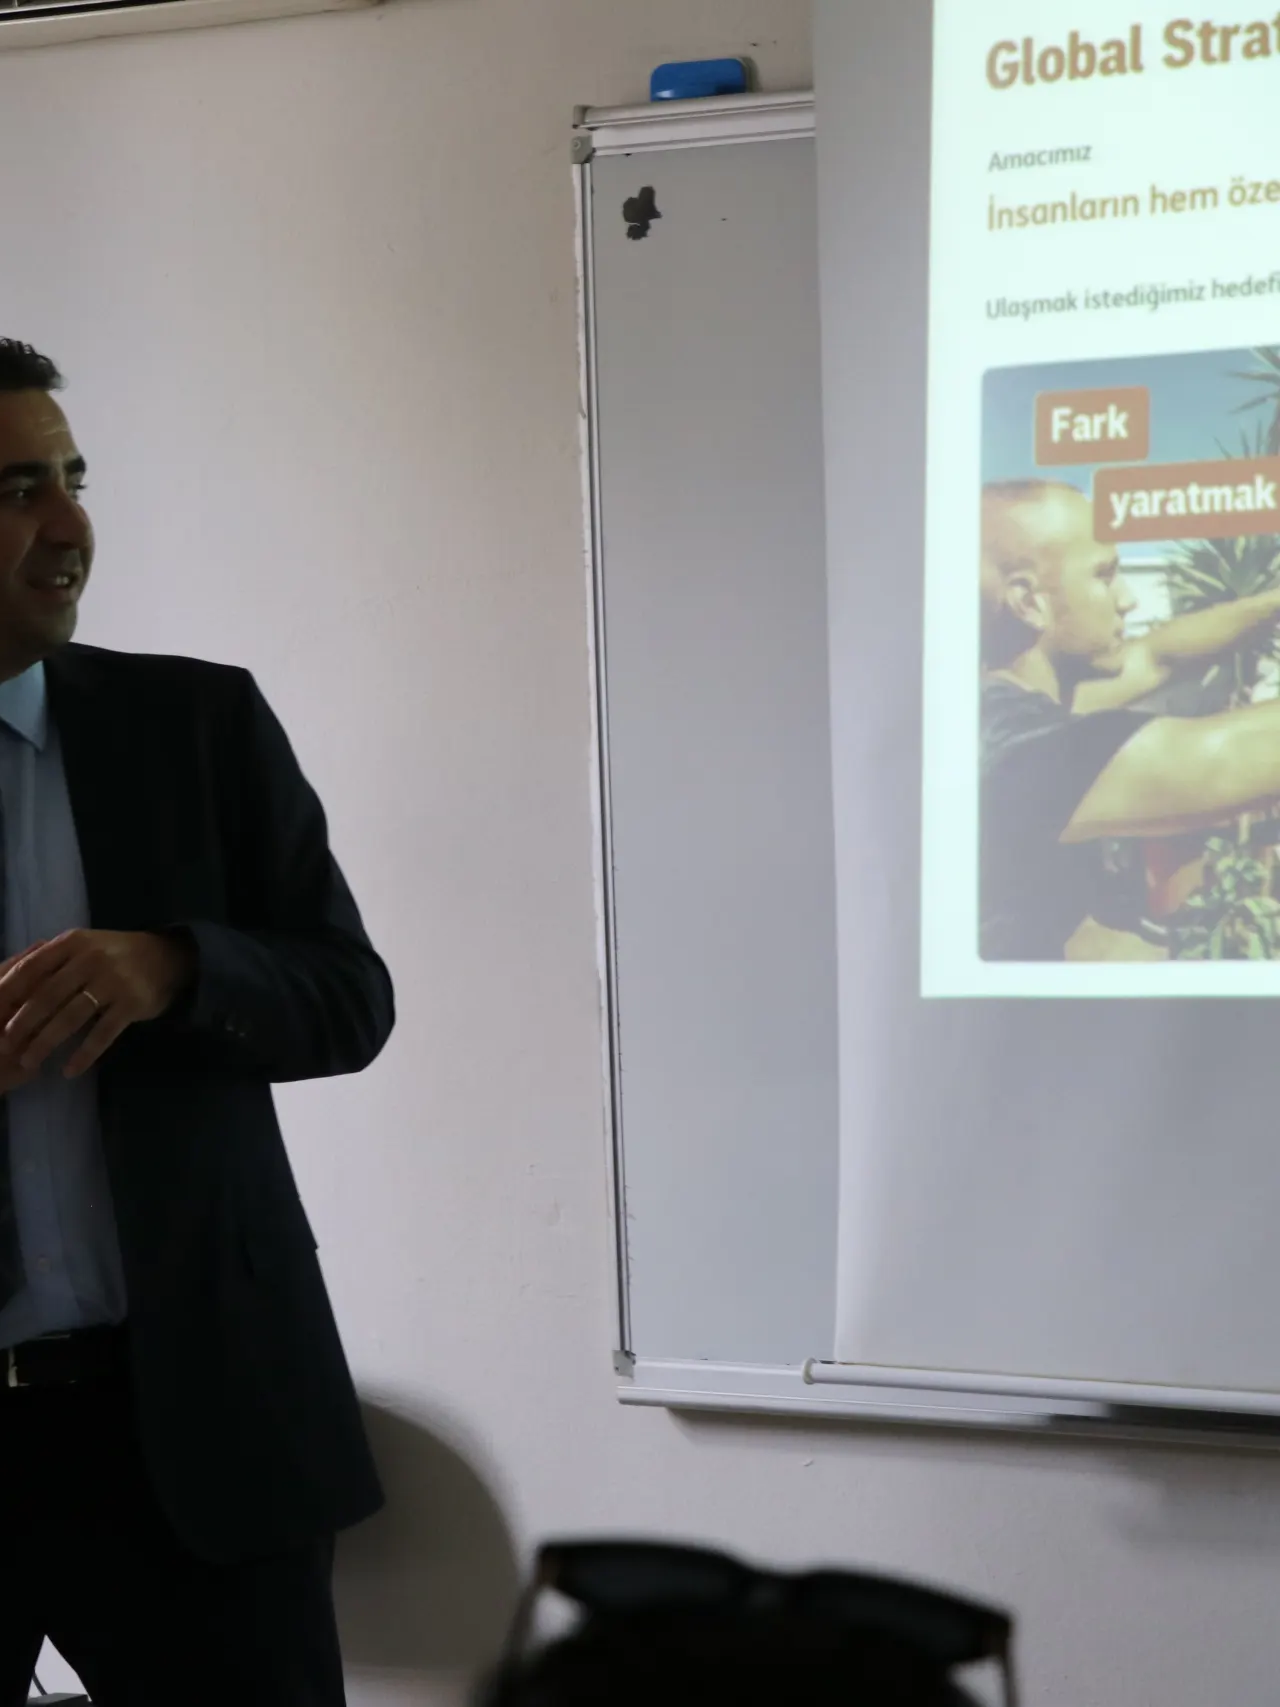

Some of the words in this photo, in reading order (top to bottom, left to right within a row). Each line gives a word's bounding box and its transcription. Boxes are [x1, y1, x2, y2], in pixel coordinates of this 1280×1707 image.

[985, 23, 1144, 90] Global
[988, 145, 1092, 172] Amacımız
[987, 191, 1139, 231] İnsanların
[1149, 183, 1218, 215] hem
[986, 291, 1077, 321] Ulaşmak
[1084, 279, 1205, 311] istediğimiz
[1051, 404, 1129, 443] Fark
[1109, 474, 1276, 529] yaratmak
